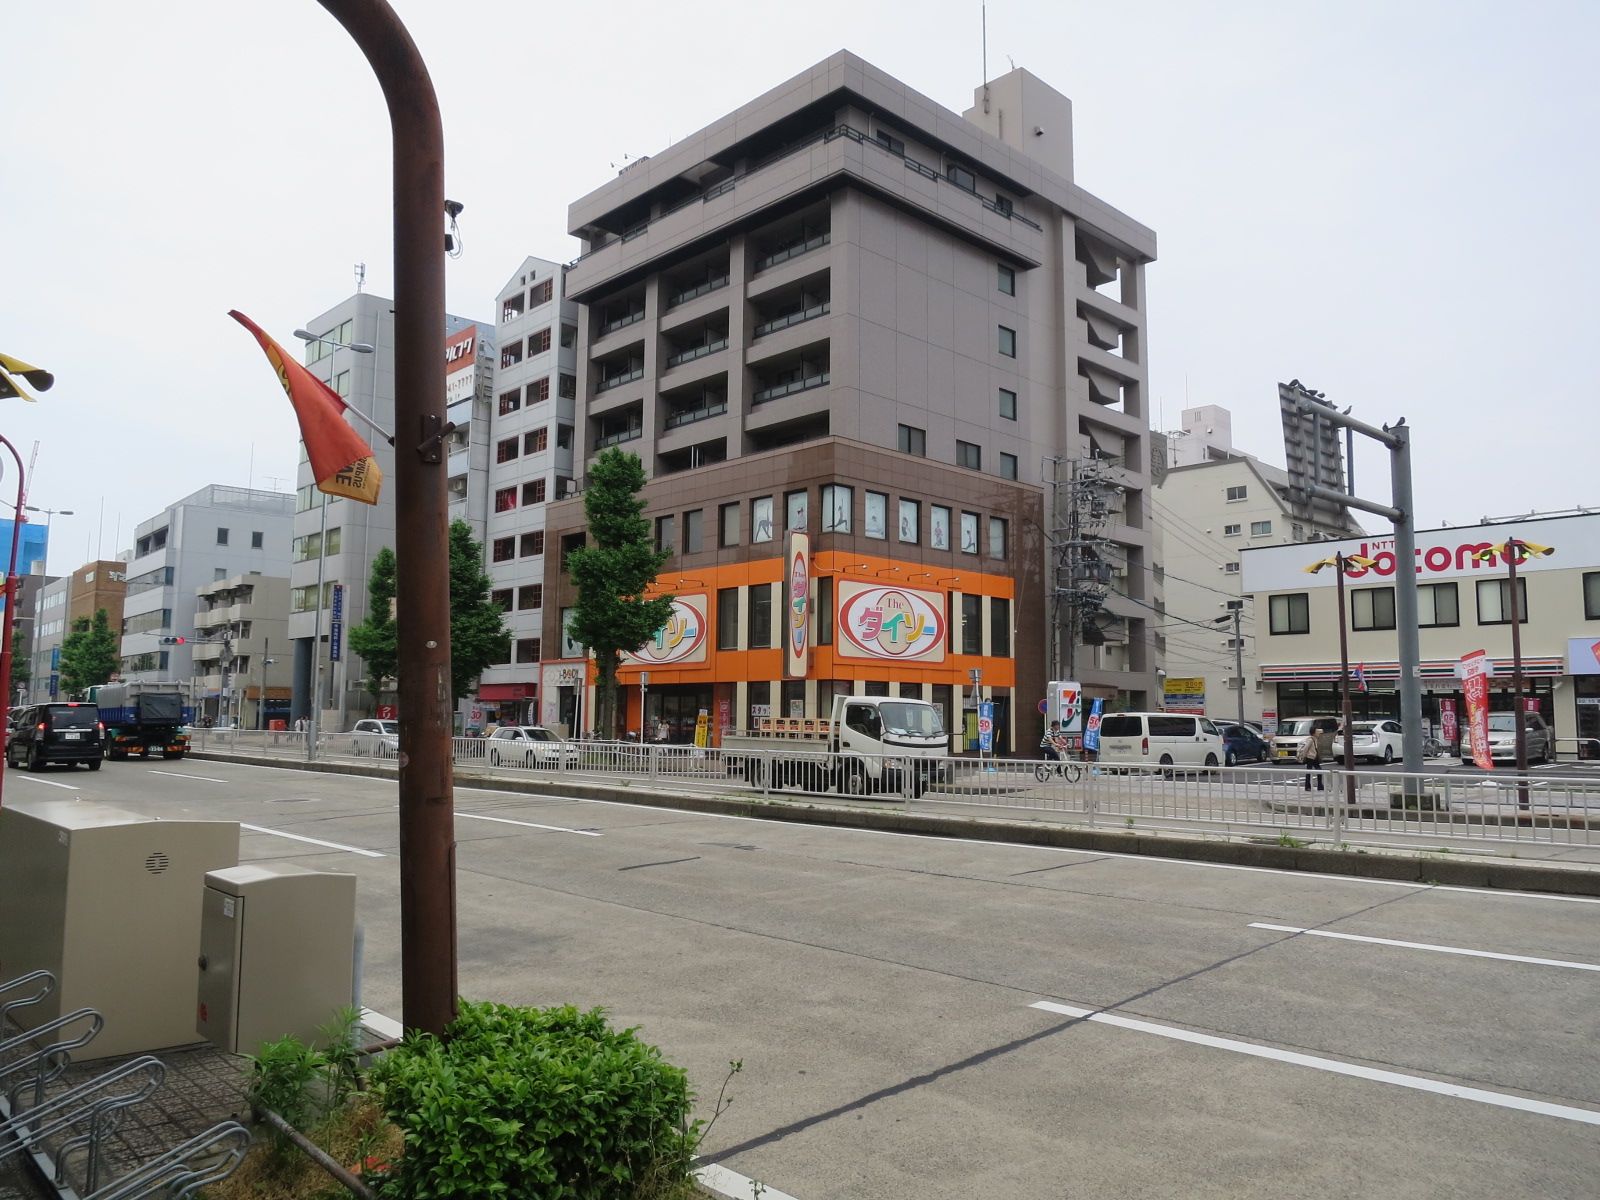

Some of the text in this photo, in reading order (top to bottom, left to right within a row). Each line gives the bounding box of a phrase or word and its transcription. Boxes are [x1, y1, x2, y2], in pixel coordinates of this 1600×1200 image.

[792, 581, 806, 644] ダイソー
[886, 597, 904, 610] The
[859, 606, 936, 643] ダイソー
[752, 706, 771, 715] スタッ
